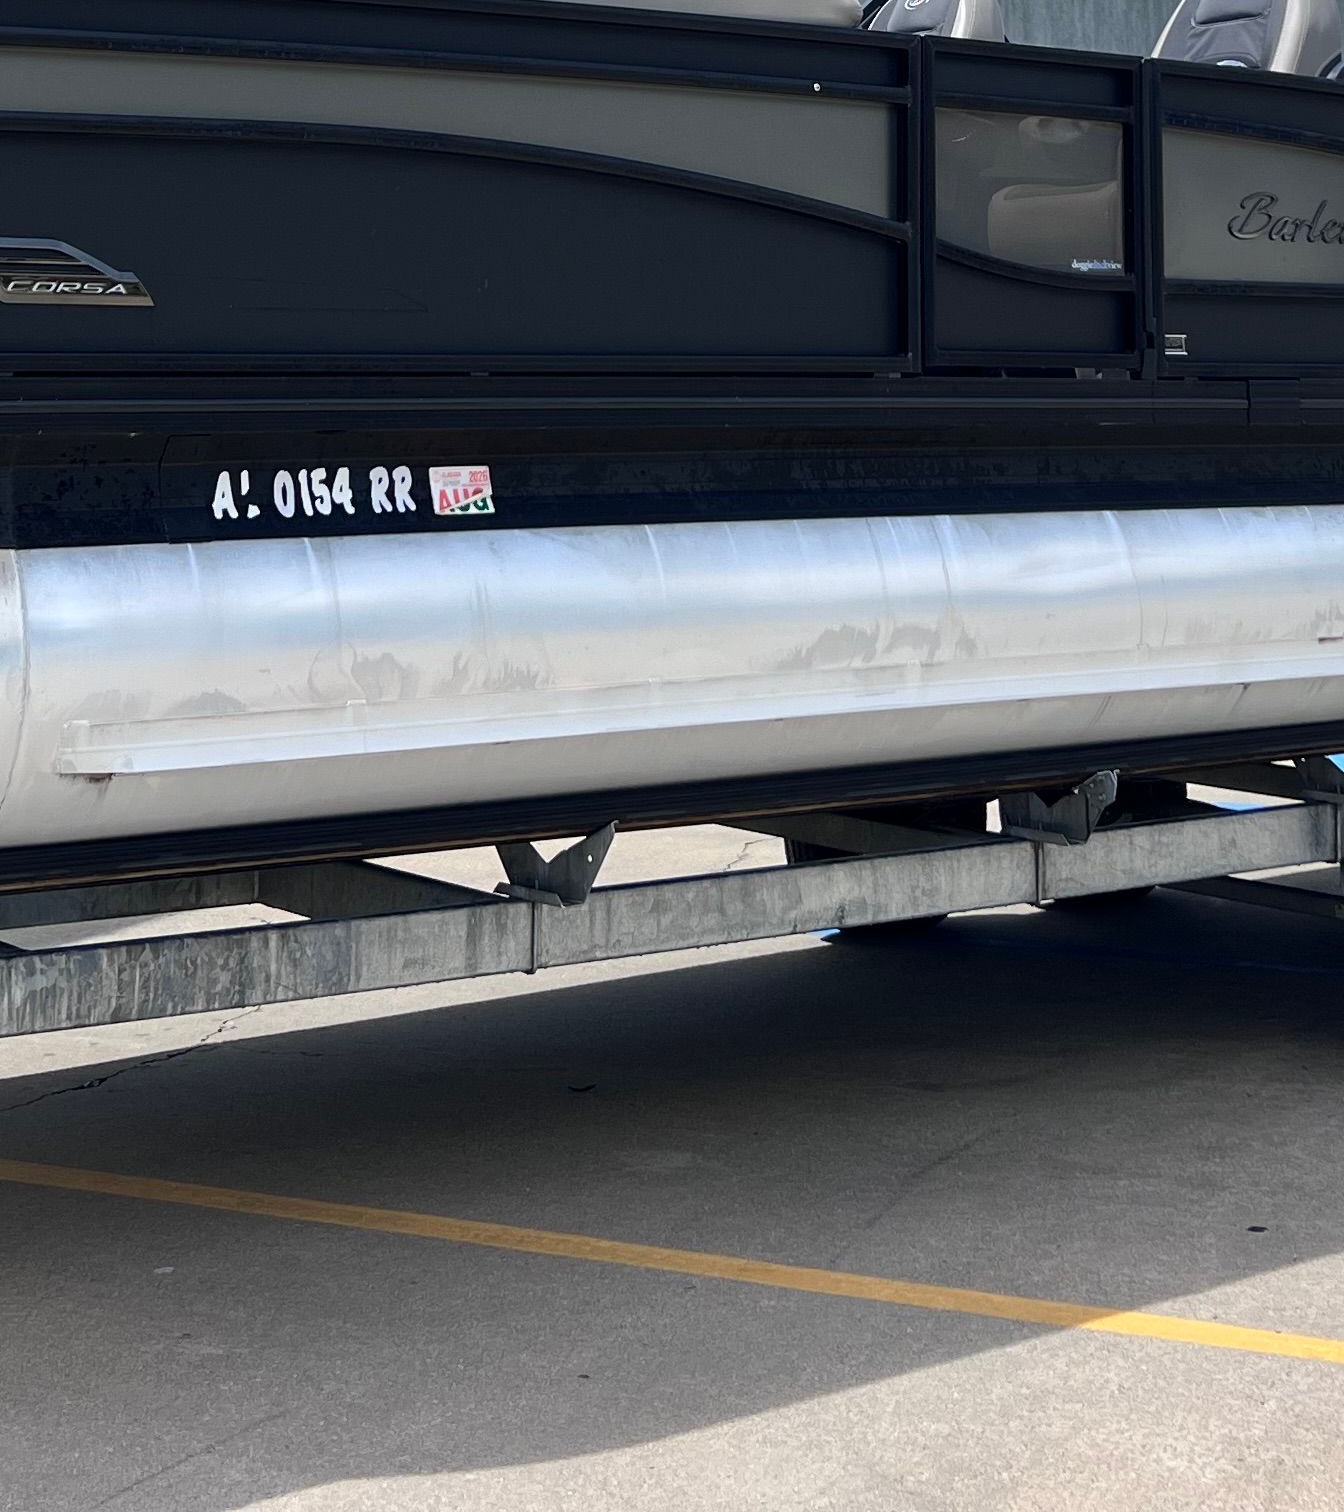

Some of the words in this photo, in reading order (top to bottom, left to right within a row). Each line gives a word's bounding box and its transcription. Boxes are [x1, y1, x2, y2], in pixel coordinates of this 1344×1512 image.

[7, 280, 128, 295] CORSA
[274, 466, 355, 518] 0154
[369, 466, 416, 514] RR
